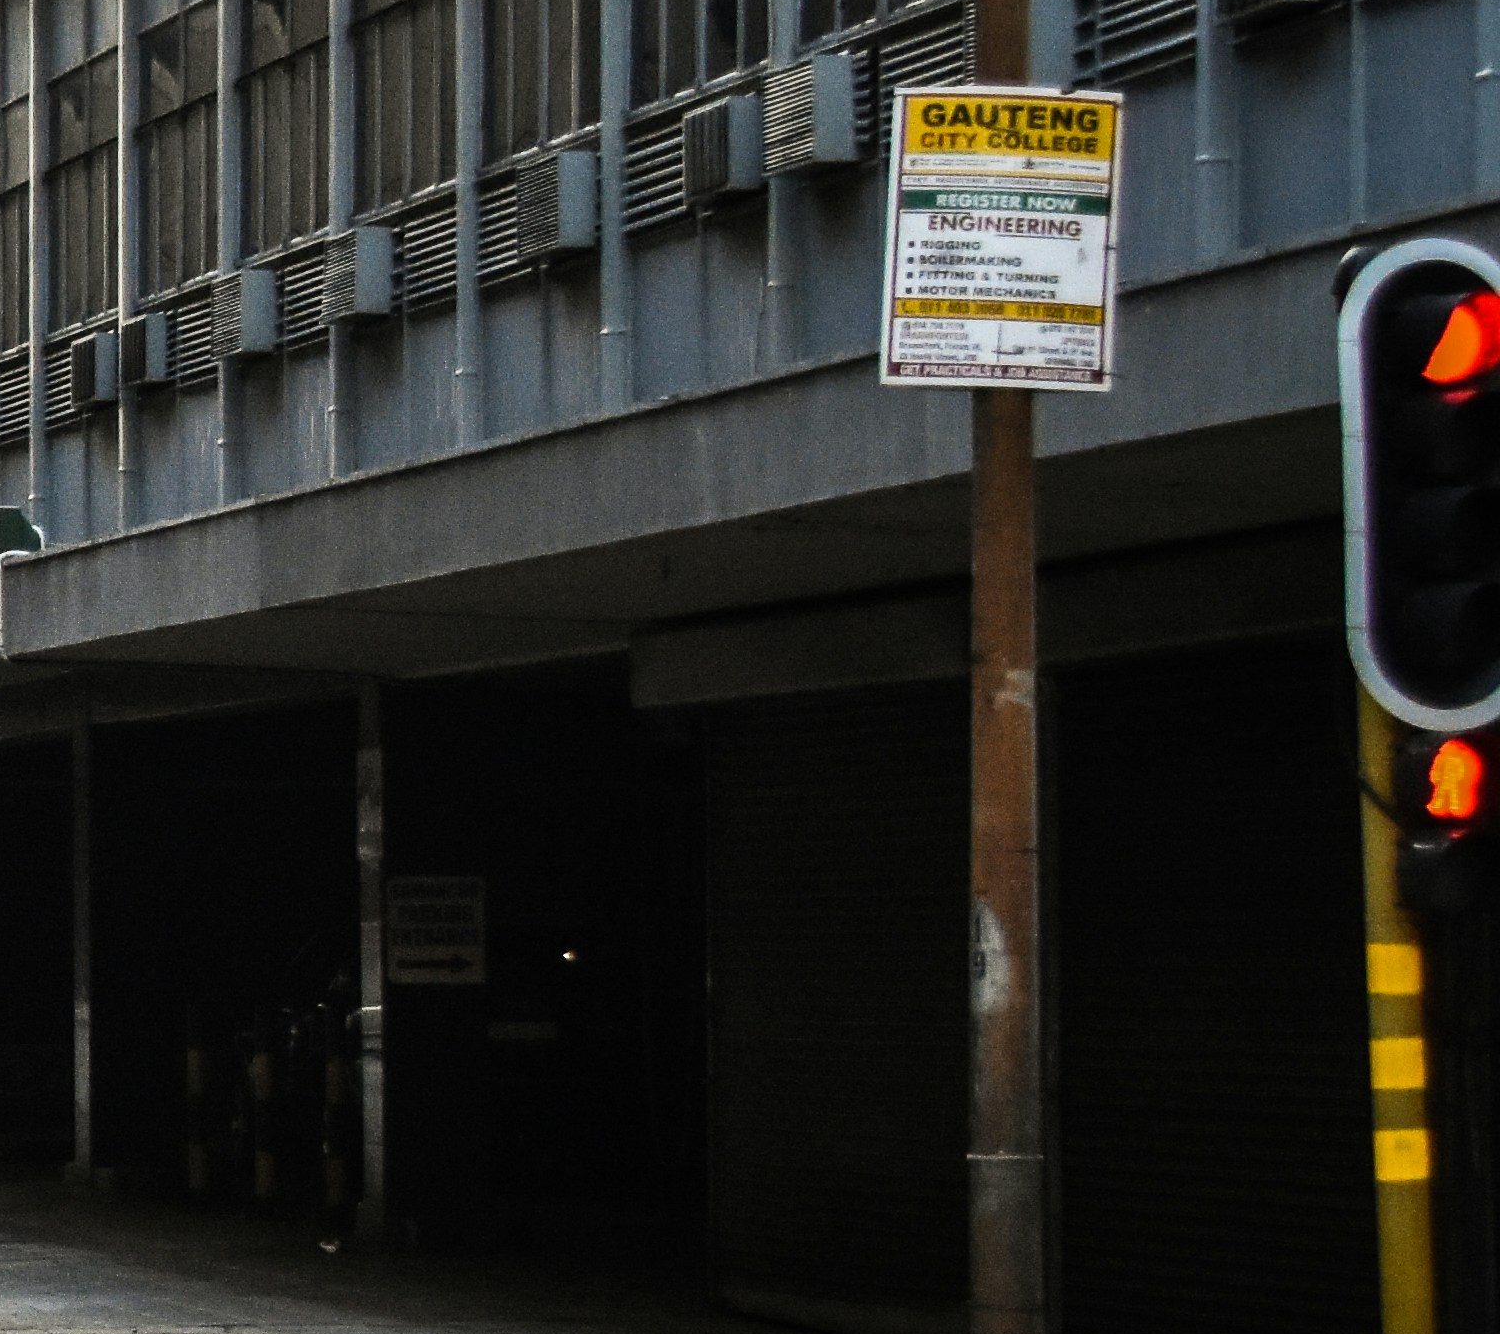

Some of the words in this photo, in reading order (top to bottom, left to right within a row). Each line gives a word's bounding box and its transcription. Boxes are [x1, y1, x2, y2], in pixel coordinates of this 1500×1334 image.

[921, 102, 1099, 133] GAUTENG
[920, 132, 977, 149] CITY
[987, 134, 1098, 154] COLLEGE
[936, 193, 1021, 210] REGISTER
[1028, 197, 1077, 212] NOW
[928, 215, 1082, 237] ENGINEERING
[920, 241, 981, 251] RIGGING
[918, 255, 1023, 267] BOILERMAKING
[918, 271, 975, 281] FITTING
[997, 273, 1059, 285] TURNING
[918, 285, 968, 296] MOTOR
[973, 287, 1057, 300] MECHANICS
